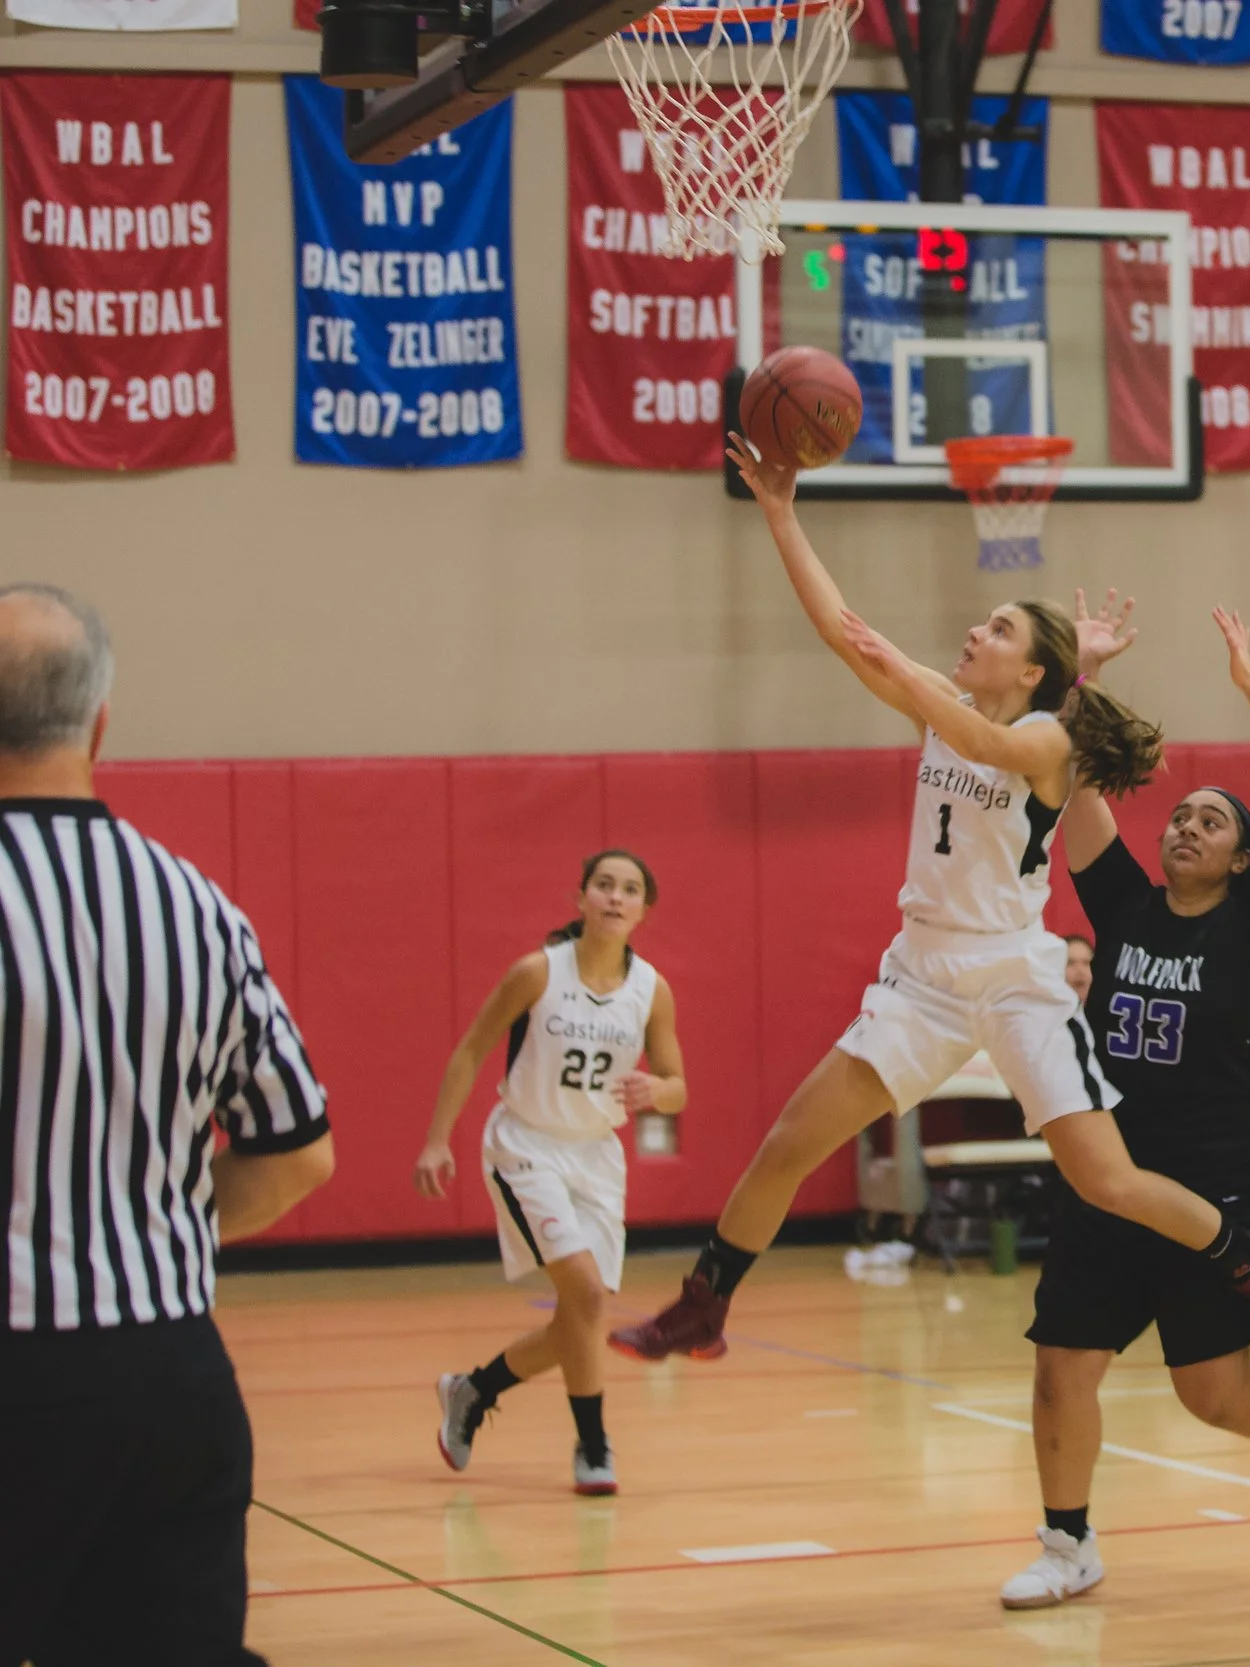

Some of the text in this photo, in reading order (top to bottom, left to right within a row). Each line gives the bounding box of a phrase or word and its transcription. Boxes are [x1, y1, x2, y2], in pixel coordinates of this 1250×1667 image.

[1162, 0, 1241, 39] 2007
[56, 120, 173, 165] WBAL
[22, 199, 212, 251] CHAMPIONS
[363, 180, 443, 226] MVP
[303, 243, 505, 297] BASKETBALL
[12, 284, 222, 336] BASKETBALL
[591, 288, 738, 340] SOFTBAL
[307, 316, 504, 368] EVE ZELINGER
[25, 370, 215, 422] 2007-2008
[312, 388, 504, 438] 2007-2008
[633, 378, 721, 424] 2008
[934, 803, 952, 855] 1
[1115, 942, 1205, 992] WOLFPACK
[1106, 991, 1187, 1066] 33
[559, 1048, 613, 1091] 22
